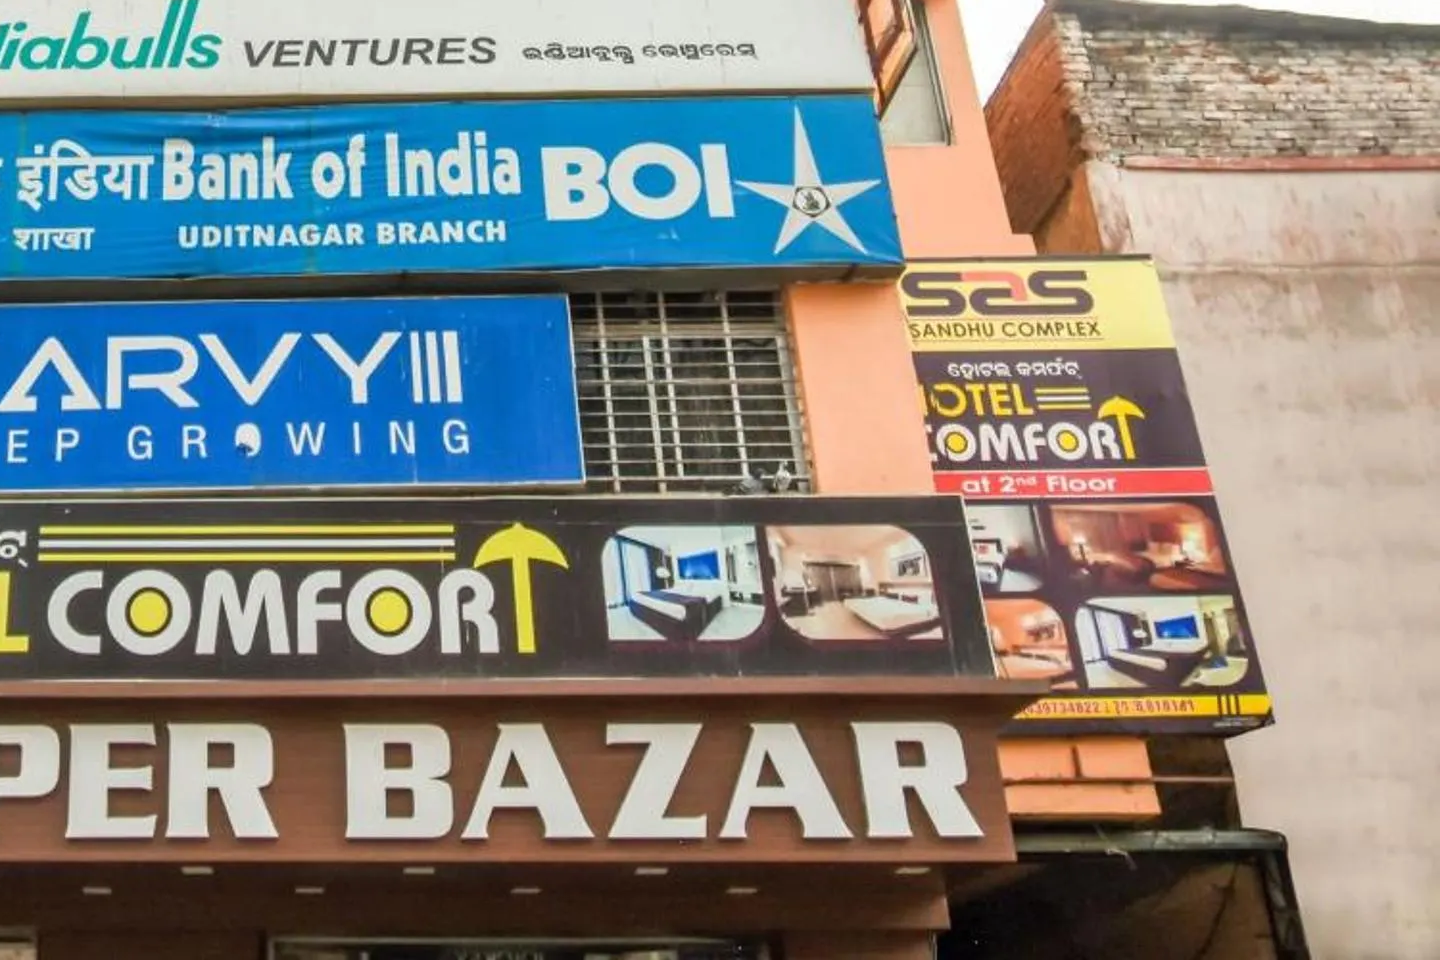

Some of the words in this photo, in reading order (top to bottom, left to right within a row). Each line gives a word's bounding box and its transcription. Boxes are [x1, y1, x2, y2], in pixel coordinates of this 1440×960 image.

[244, 37, 496, 67] VENTURES
[16, 139, 154, 211] इंडिया
[163, 138, 294, 200] Bank
[311, 134, 365, 199] of
[385, 131, 521, 197] India
[541, 143, 738, 220] BOI
[13, 228, 95, 250] शाखा
[179, 224, 364, 248] UDITNAGAR
[377, 220, 505, 244] BRANCH
[908, 323, 993, 338] SANDHU
[1002, 322, 1100, 337] COMPLEX
[926, 394, 1144, 461] OMFORT
[962, 478, 989, 494] at
[999, 475, 1037, 492] 2nd
[1047, 474, 1120, 491] Floor
[46, 524, 568, 655] COMFORT
[344, 722, 985, 838] BAZAR
